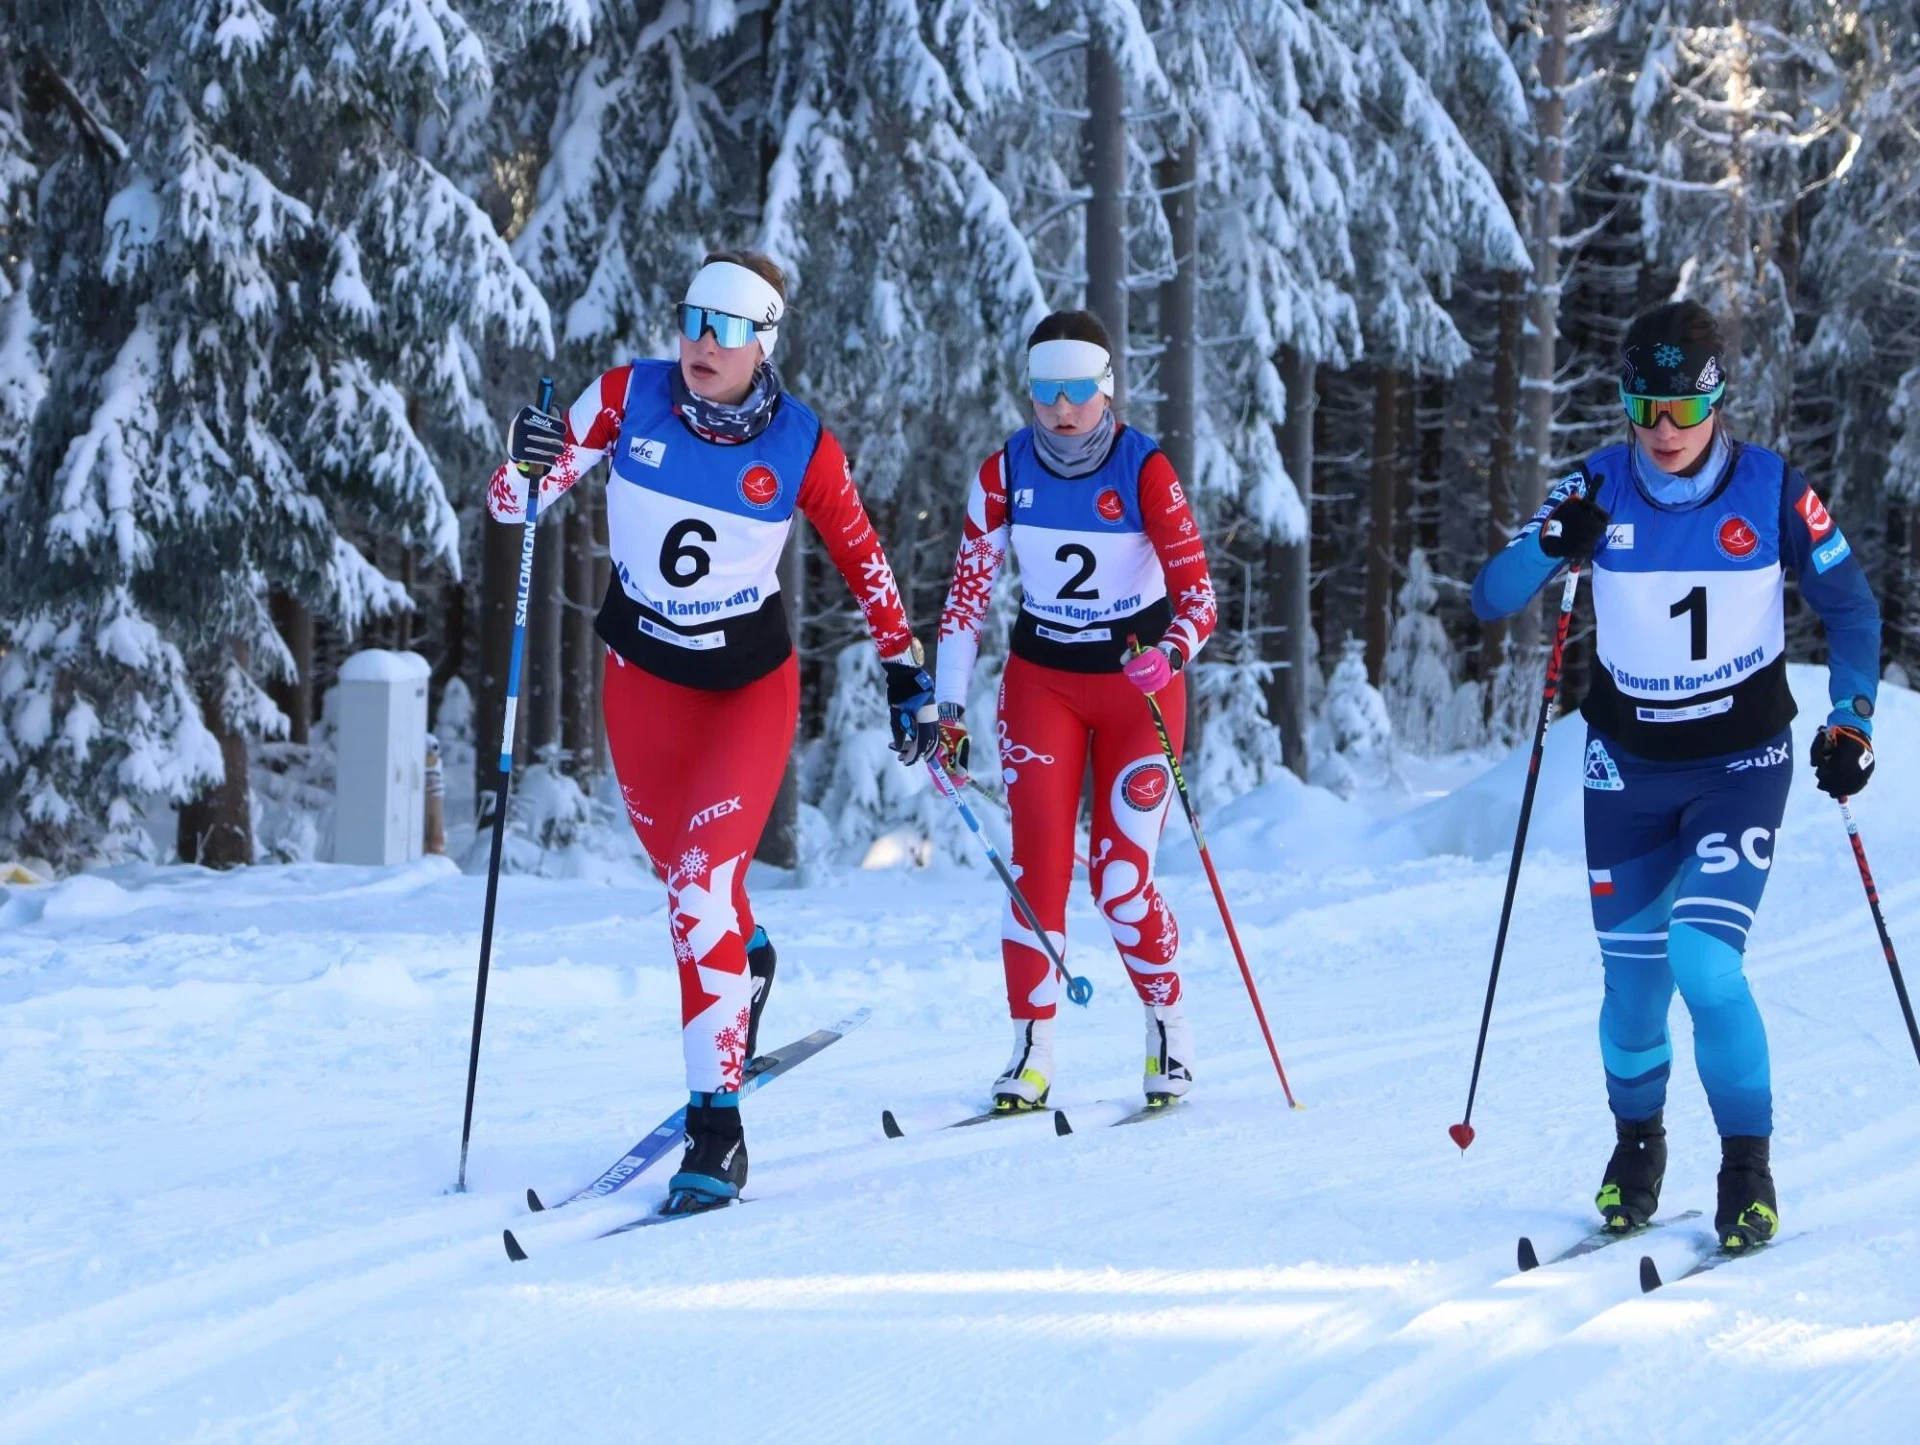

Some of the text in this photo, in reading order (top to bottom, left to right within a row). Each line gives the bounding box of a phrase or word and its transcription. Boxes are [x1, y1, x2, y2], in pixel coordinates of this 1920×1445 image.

[630, 440, 653, 459] WSC
[515, 520, 536, 628] SALOMON
[659, 518, 717, 588] 6
[1055, 543, 1100, 600] 2
[1168, 551, 1199, 569] Karlovy
[1065, 604, 1111, 622] Karlo
[1113, 593, 1142, 613] Vary
[1669, 586, 1708, 662] 1
[1617, 668, 1670, 691] Slovan
[1733, 645, 1765, 674] Vary
[688, 795, 743, 833] ATEX
[1696, 826, 1777, 875] SC
